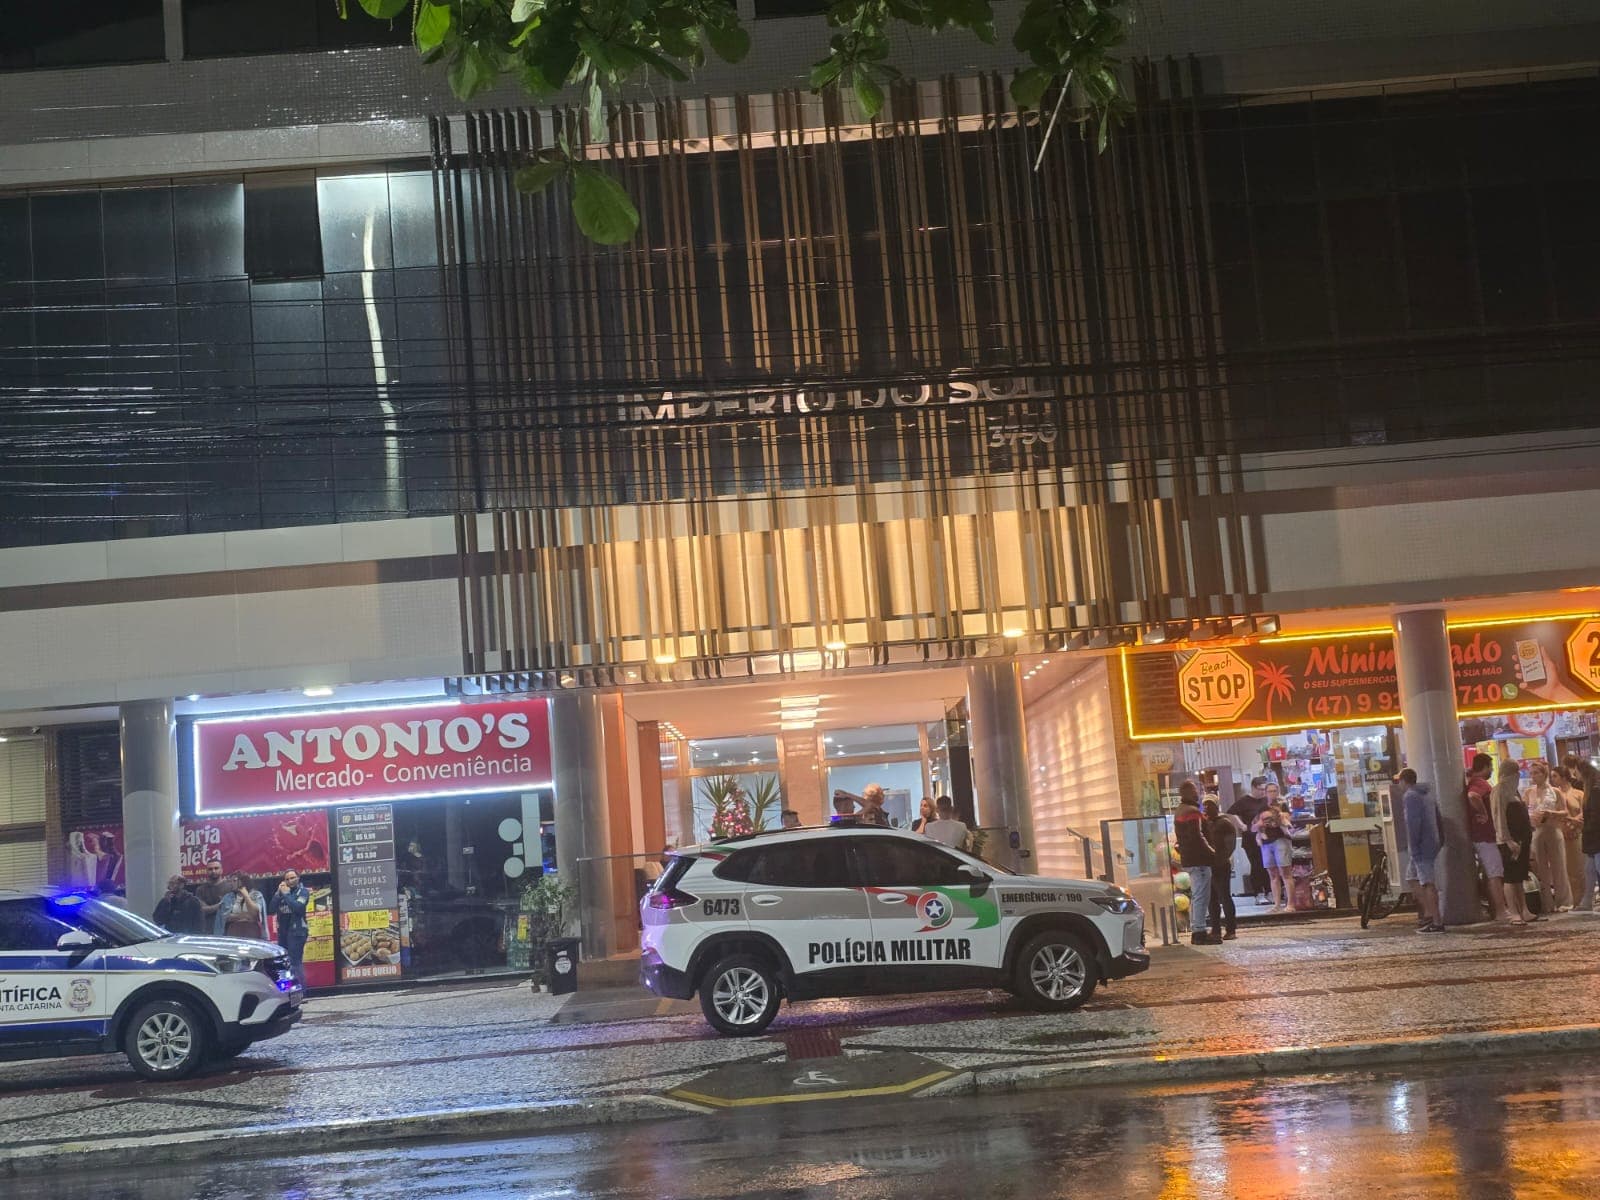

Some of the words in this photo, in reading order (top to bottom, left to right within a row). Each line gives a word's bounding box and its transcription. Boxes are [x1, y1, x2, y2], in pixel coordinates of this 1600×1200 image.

[1200, 654, 1232, 675] Beach
[1188, 674, 1246, 702] STOP
[1311, 680, 1329, 689] SEU
[1330, 675, 1398, 687] SUPERMERCAD
[1463, 669, 1480, 677] SUA
[1307, 694, 1352, 720] (47)
[1357, 693, 1372, 712] 9
[1458, 683, 1502, 705] 710
[222, 712, 530, 771] ANTONIO'S
[382, 754, 532, 783] Conveniência
[352, 865, 382, 875] FRUTAS
[349, 875, 387, 886] VERDURAS
[356, 888, 380, 896] FRIOS
[1001, 892, 1057, 903] EMERGÊNCIA
[1066, 893, 1082, 902] 190
[354, 897, 384, 907] CARNES
[703, 898, 740, 916] 6473
[808, 937, 887, 964] POLÍCIA
[891, 938, 971, 962] MILITAR
[346, 967, 361, 978] PÃO
[362, 967, 371, 977] DE
[372, 965, 397, 977] QUEIJO
[0, 985, 62, 1003] TÍFICA
[17, 1001, 62, 1011] CATARINA
